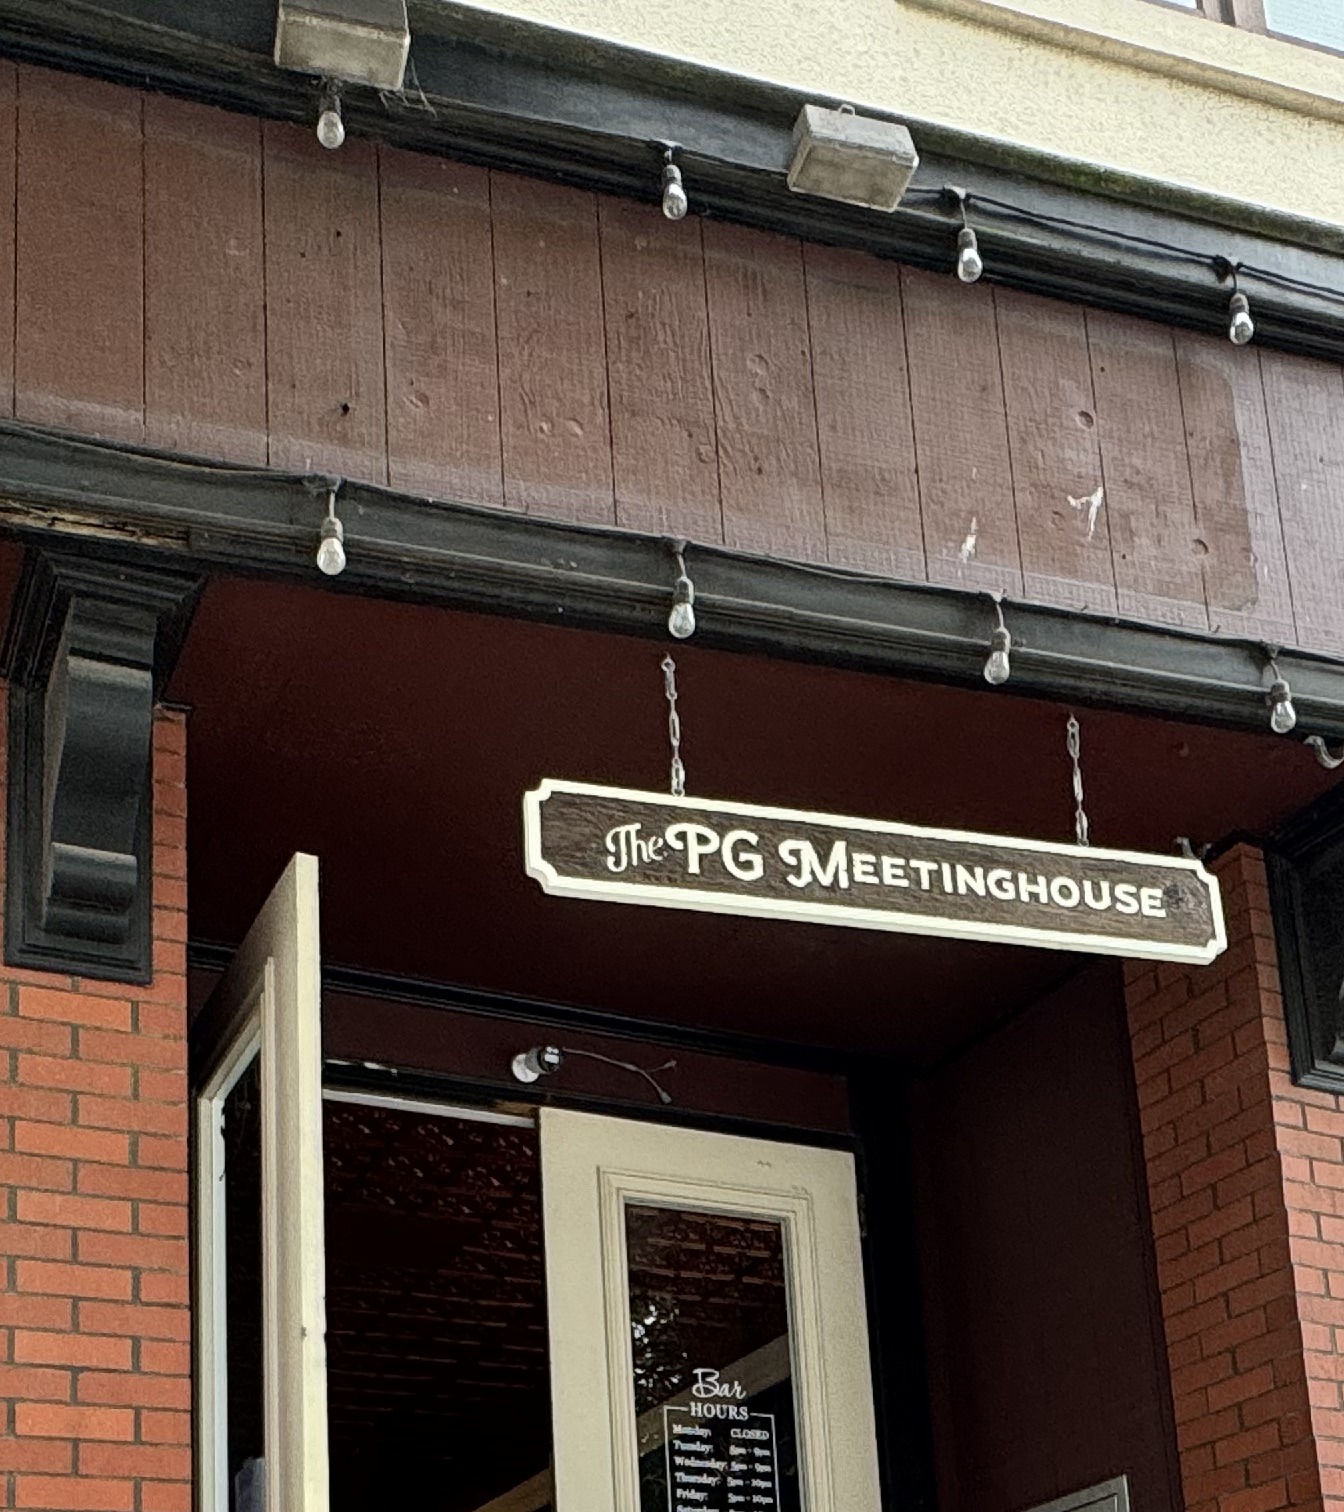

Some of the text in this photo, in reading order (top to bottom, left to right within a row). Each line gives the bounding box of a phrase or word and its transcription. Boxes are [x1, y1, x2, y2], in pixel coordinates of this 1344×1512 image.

[605, 822, 1167, 918] The PG MEETINGHOUSE
[692, 1368, 746, 1399] Bar
[690, 1402, 749, 1420] HOURS
